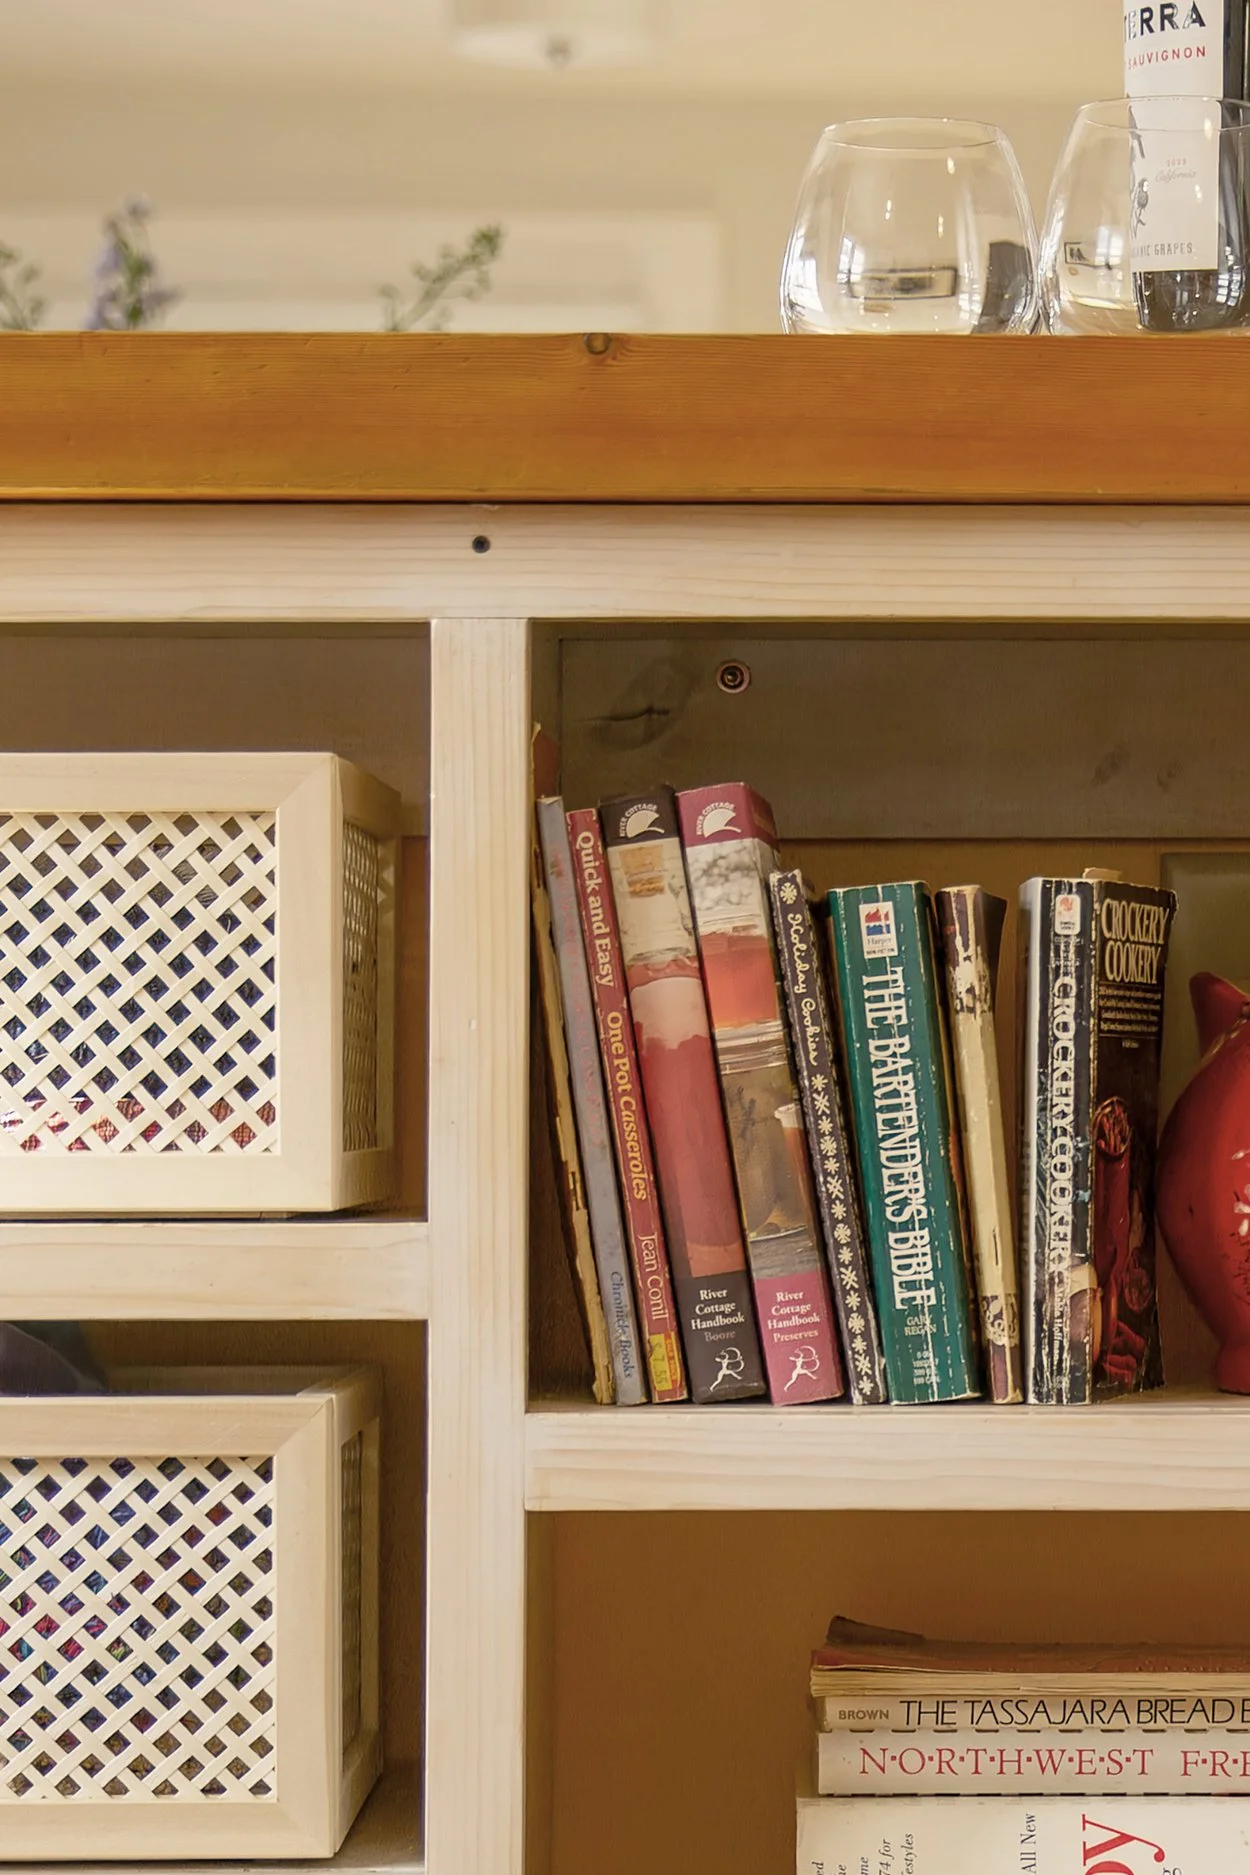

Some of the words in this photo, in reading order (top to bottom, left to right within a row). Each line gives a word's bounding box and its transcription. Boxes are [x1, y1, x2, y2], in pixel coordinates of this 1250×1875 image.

[1128, 46, 1206, 70] SAUVIGNON
[1154, 242, 1193, 256] GRAPES
[625, 803, 658, 817] COTTAGE
[702, 802, 736, 816] COTTAGE
[575, 831, 602, 894] Quick
[587, 896, 610, 936] and
[1101, 898, 1170, 944] CROCKERY
[595, 937, 615, 988] Easy
[1105, 941, 1162, 984] COOKERY
[787, 912, 810, 994] Holiday
[801, 997, 820, 1066] Cookies
[862, 966, 909, 1029] THE
[607, 1011, 623, 1054] One
[1051, 976, 1076, 1132] CROCKERY
[613, 1057, 632, 1094] Pot
[620, 1095, 648, 1200] Casseroles
[868, 1034, 928, 1223] BARTENDER'S
[1049, 1137, 1075, 1273] COOKERY
[637, 1231, 658, 1272] Jean
[888, 1227, 937, 1310] BIBLE
[611, 1271, 628, 1337] Chronicle
[647, 1276, 668, 1320] Conil
[695, 1302, 736, 1315] Cottage
[700, 1289, 727, 1300] River
[771, 1303, 811, 1315] Cottage
[776, 1291, 803, 1302] River
[691, 1311, 745, 1330] Handbook
[768, 1312, 820, 1330] Handbook
[773, 1330, 818, 1342] Preserves
[619, 1340, 635, 1379] Books
[838, 1709, 889, 1721] BROWN
[900, 1700, 957, 1725] THE
[964, 1699, 1131, 1725] TASSAJARA
[1136, 1699, 1235, 1724] BREAD
[1020, 1813, 1036, 1844] New
[878, 1839, 895, 1860] for
[1020, 1851, 1036, 1874] All
